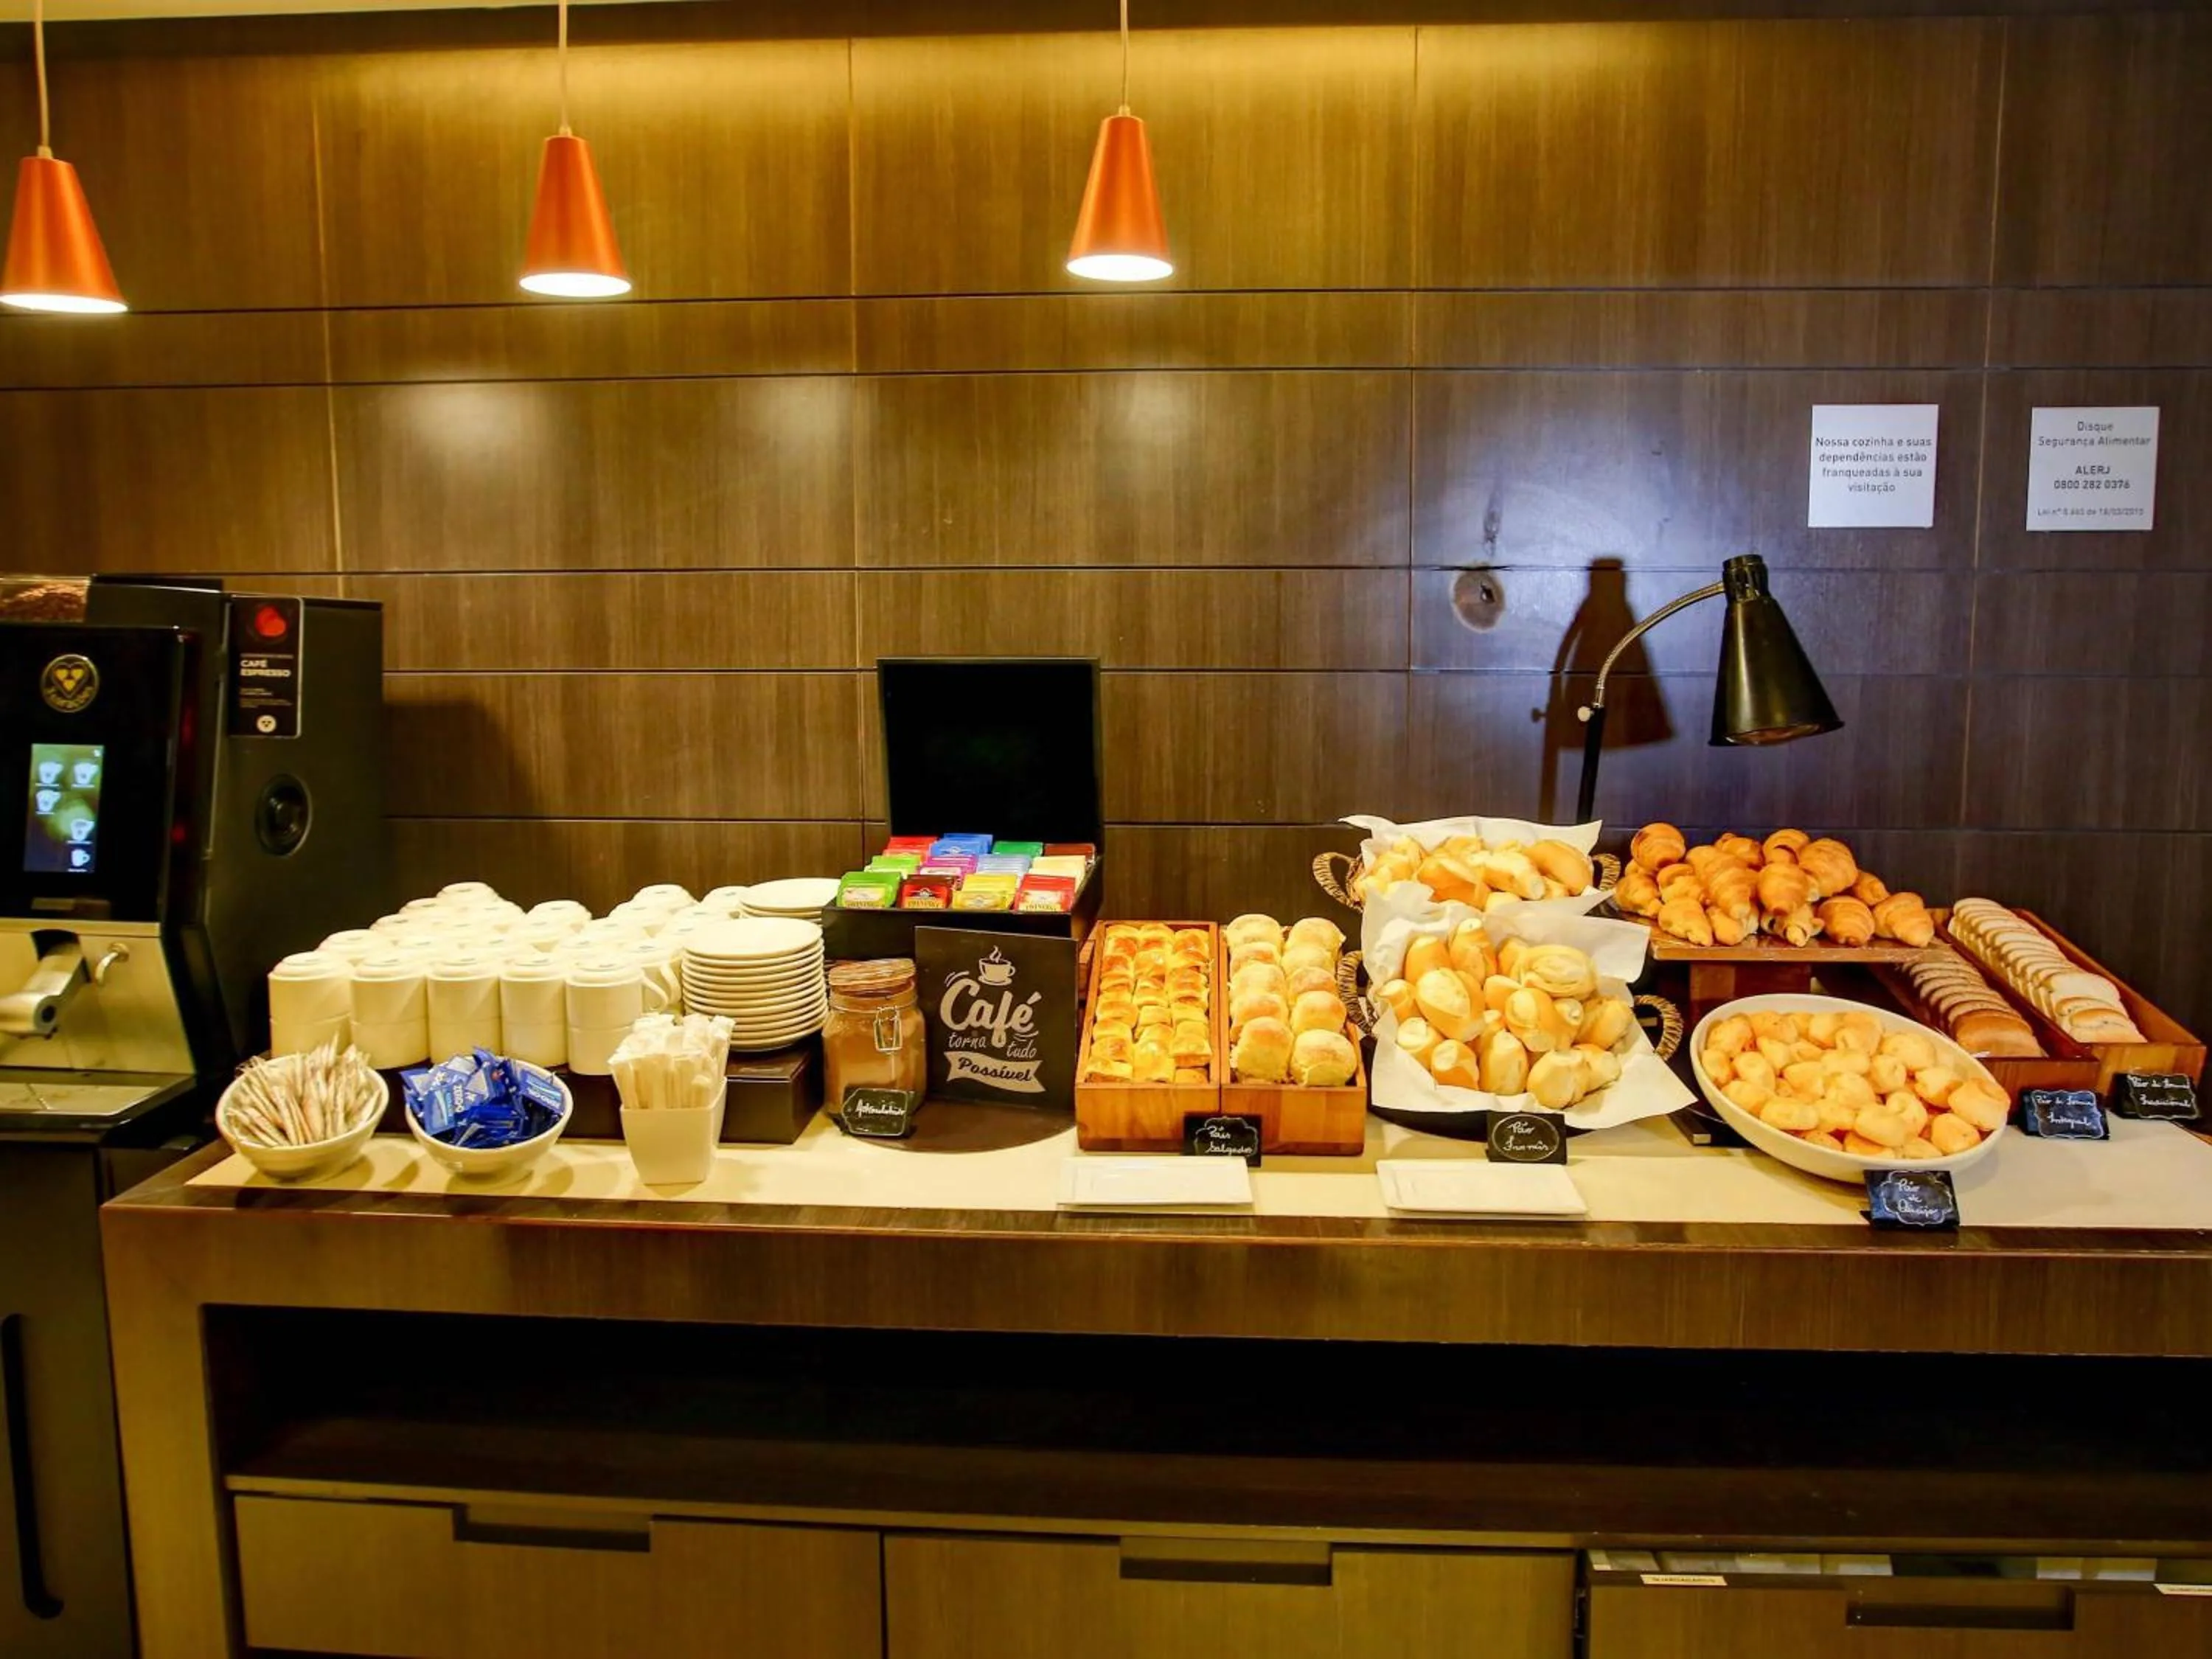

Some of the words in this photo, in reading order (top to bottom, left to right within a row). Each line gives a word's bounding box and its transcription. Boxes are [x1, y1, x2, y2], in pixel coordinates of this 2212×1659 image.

[2077, 421, 2114, 433] Disque
[1816, 437, 1849, 447] Nossa
[1852, 437, 1893, 447] cozinha
[1897, 439, 1904, 447] e
[1906, 439, 1932, 447] suas
[2038, 437, 2095, 448] Segurança
[2098, 437, 2152, 446] Alimentar
[1819, 452, 1894, 464] dependências
[1897, 452, 1927, 462] estão
[1822, 467, 1891, 478] franqueadas
[1893, 467, 1900, 477] à
[1902, 469, 1922, 477] sua
[2075, 465, 2111, 475] ALERJ
[1848, 483, 1896, 494] visitação
[2053, 480, 2080, 490] 0800
[2082, 480, 2101, 490] 282
[940, 978, 1042, 1048] Café
[948, 1032, 987, 1049] torna
[1006, 1040, 1037, 1058] tudo
[958, 1057, 1032, 1082] Possível
